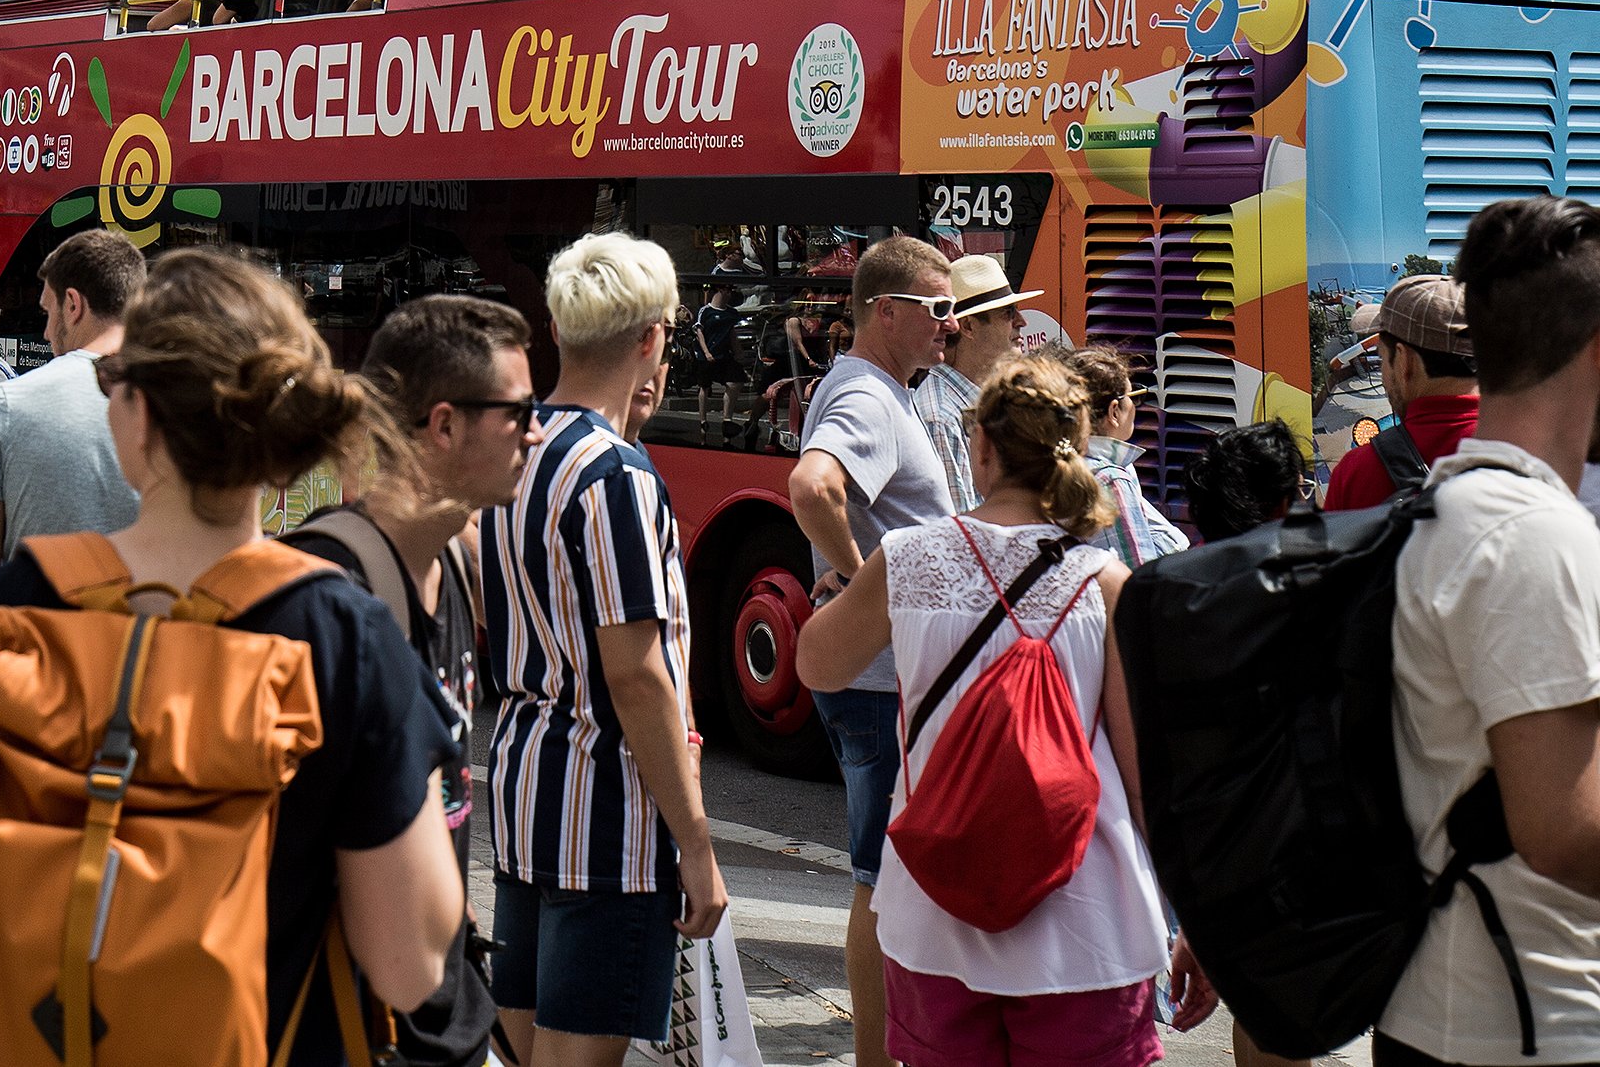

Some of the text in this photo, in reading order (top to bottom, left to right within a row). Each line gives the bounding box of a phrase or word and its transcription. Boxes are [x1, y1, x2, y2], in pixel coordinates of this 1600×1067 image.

[819, 40, 836, 50] 2018
[946, 54, 1049, 83] Barcelona's
[189, 12, 759, 158] BARCELONA City Tour
[603, 131, 744, 153] www.barcelonacitytour.es
[811, 139, 840, 151] WINNER
[939, 131, 1056, 148] www.illafantasia.com
[1088, 131, 1103, 141] MORE
[934, 185, 1013, 226] 2543
